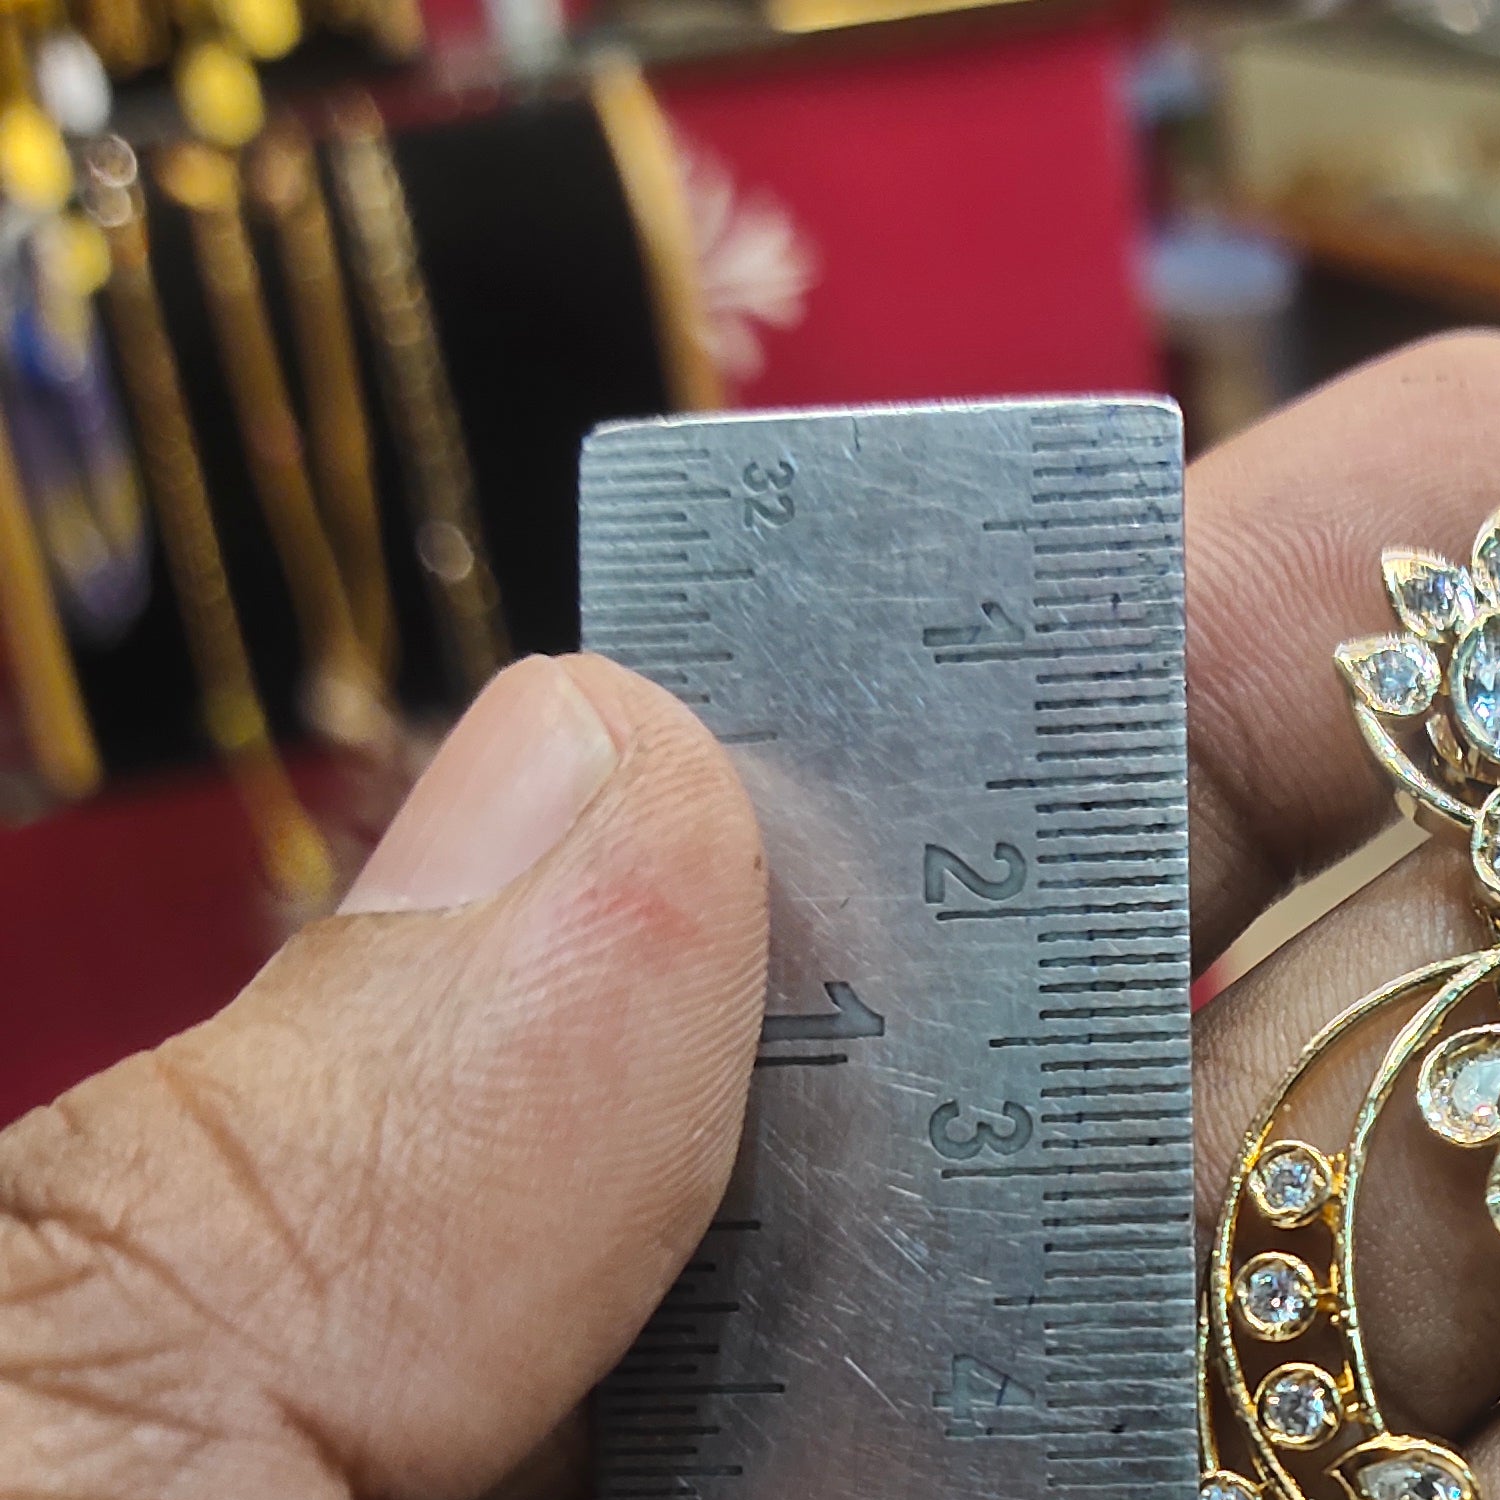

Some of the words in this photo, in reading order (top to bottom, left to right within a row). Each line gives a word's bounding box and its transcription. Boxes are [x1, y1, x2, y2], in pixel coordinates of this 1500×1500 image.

[743, 460, 795, 532] 32
[923, 602, 1025, 647] 1
[925, 842, 1027, 904] 2
[762, 981, 885, 1041] 1
[929, 1100, 1034, 1160] 3
[933, 1354, 1035, 1424] 4
